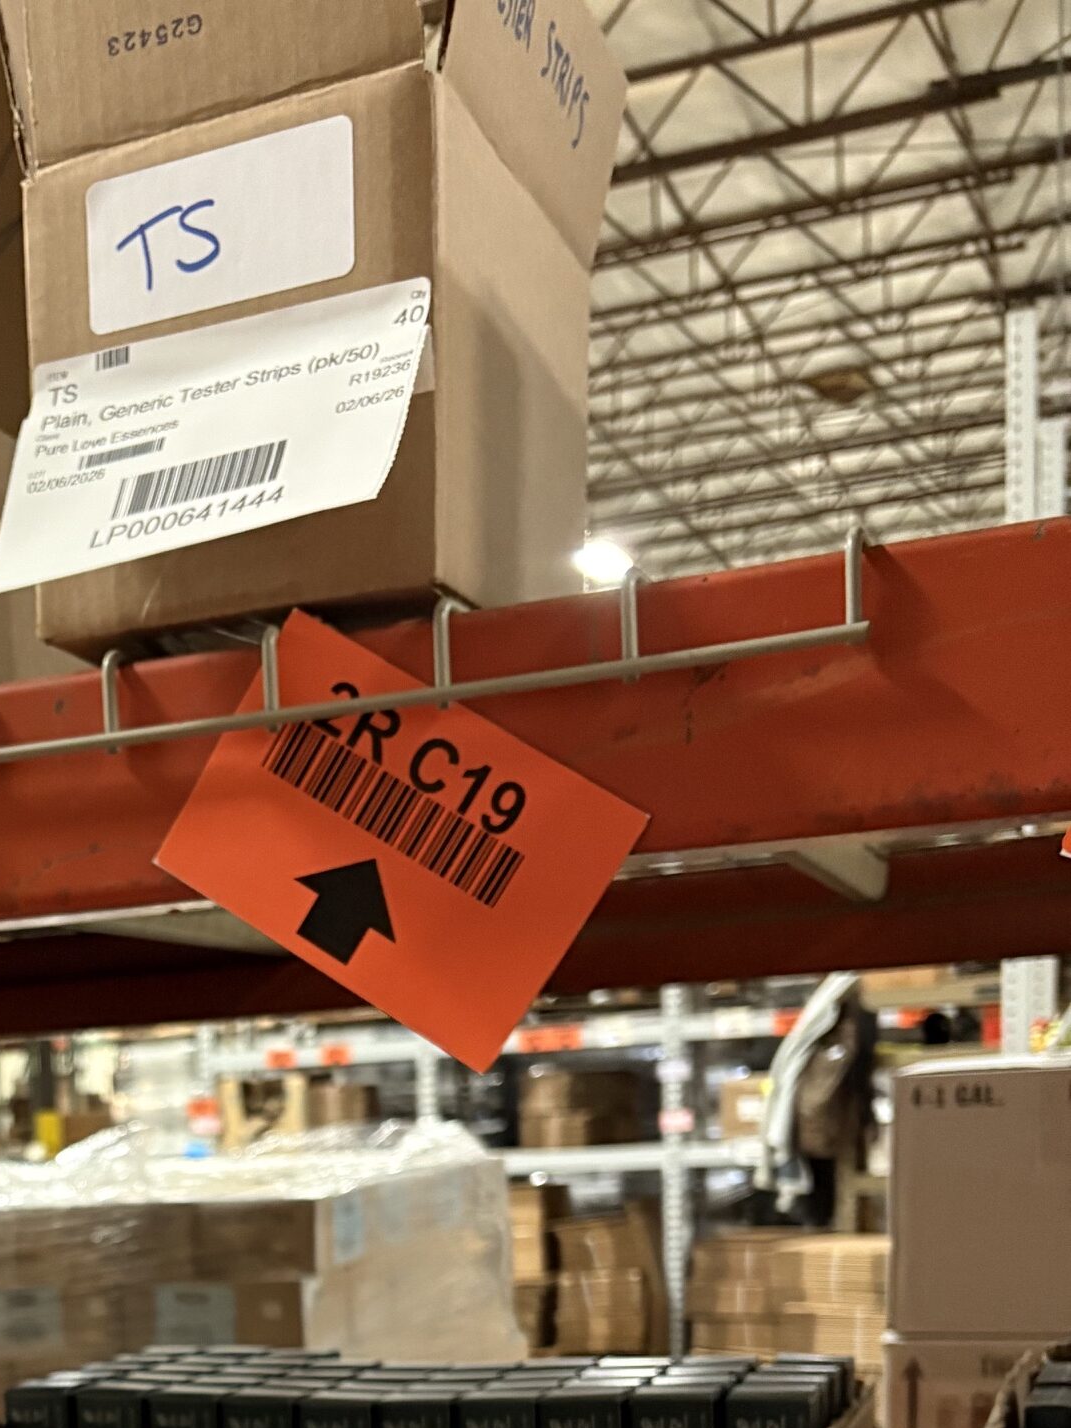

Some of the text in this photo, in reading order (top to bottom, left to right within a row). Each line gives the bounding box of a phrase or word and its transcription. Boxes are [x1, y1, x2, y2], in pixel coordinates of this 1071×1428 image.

[107, 13, 203, 57] G25423
[540, 20, 590, 149] STRIPS
[116, 199, 221, 291] TS
[393, 304, 425, 326] 40
[40, 341, 380, 432] Plain, Generic Tester Strips (pk/50)
[48, 384, 78, 407] TS
[335, 384, 405, 415] 02/06/26
[34, 419, 180, 458] Pure Love Essences
[89, 485, 285, 550] LP000641444
[408, 738, 526, 835] C19
